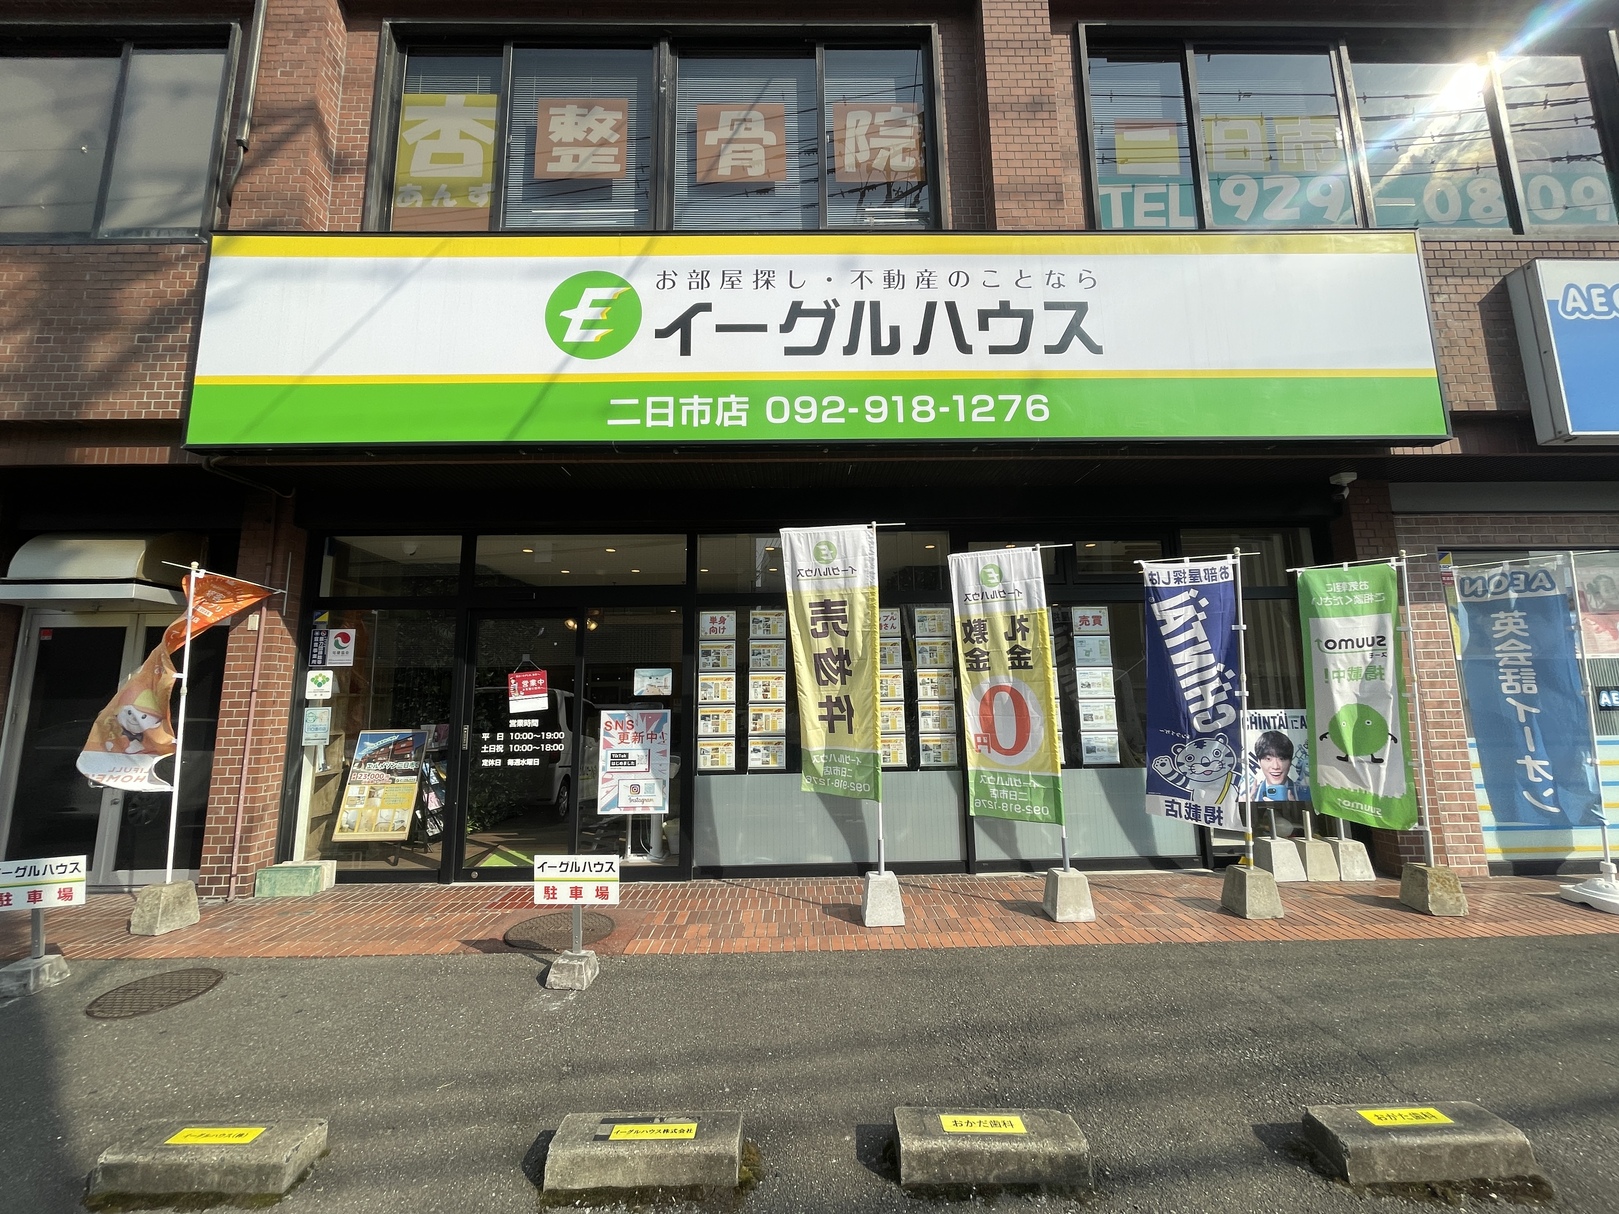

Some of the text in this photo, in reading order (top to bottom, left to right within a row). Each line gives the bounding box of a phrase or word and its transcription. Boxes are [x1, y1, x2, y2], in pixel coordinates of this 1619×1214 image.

[401, 95, 496, 179] 杏
[397, 184, 495, 208] あんず
[1099, 183, 1194, 228] TEL
[655, 268, 1098, 291] お部屋探し・不動産のことなら
[1559, 284, 1619, 320] AE
[654, 298, 1104, 357] イーグルハウス
[607, 394, 1051, 428] 二日市店 092-918-1276
[709, 615, 727, 625] 単身
[1079, 615, 1103, 627] 売買
[709, 626, 726, 635] 向け
[509, 719, 539, 728] 営業時間
[604, 719, 635, 731] SNS
[481, 744, 504, 753] 土日祝
[481, 759, 501, 767] 定休日
[0, 861, 82, 878] ーグルハウス
[537, 861, 616, 873] イーグルハウス
[952, 1119, 1014, 1129] おかだ歯科
